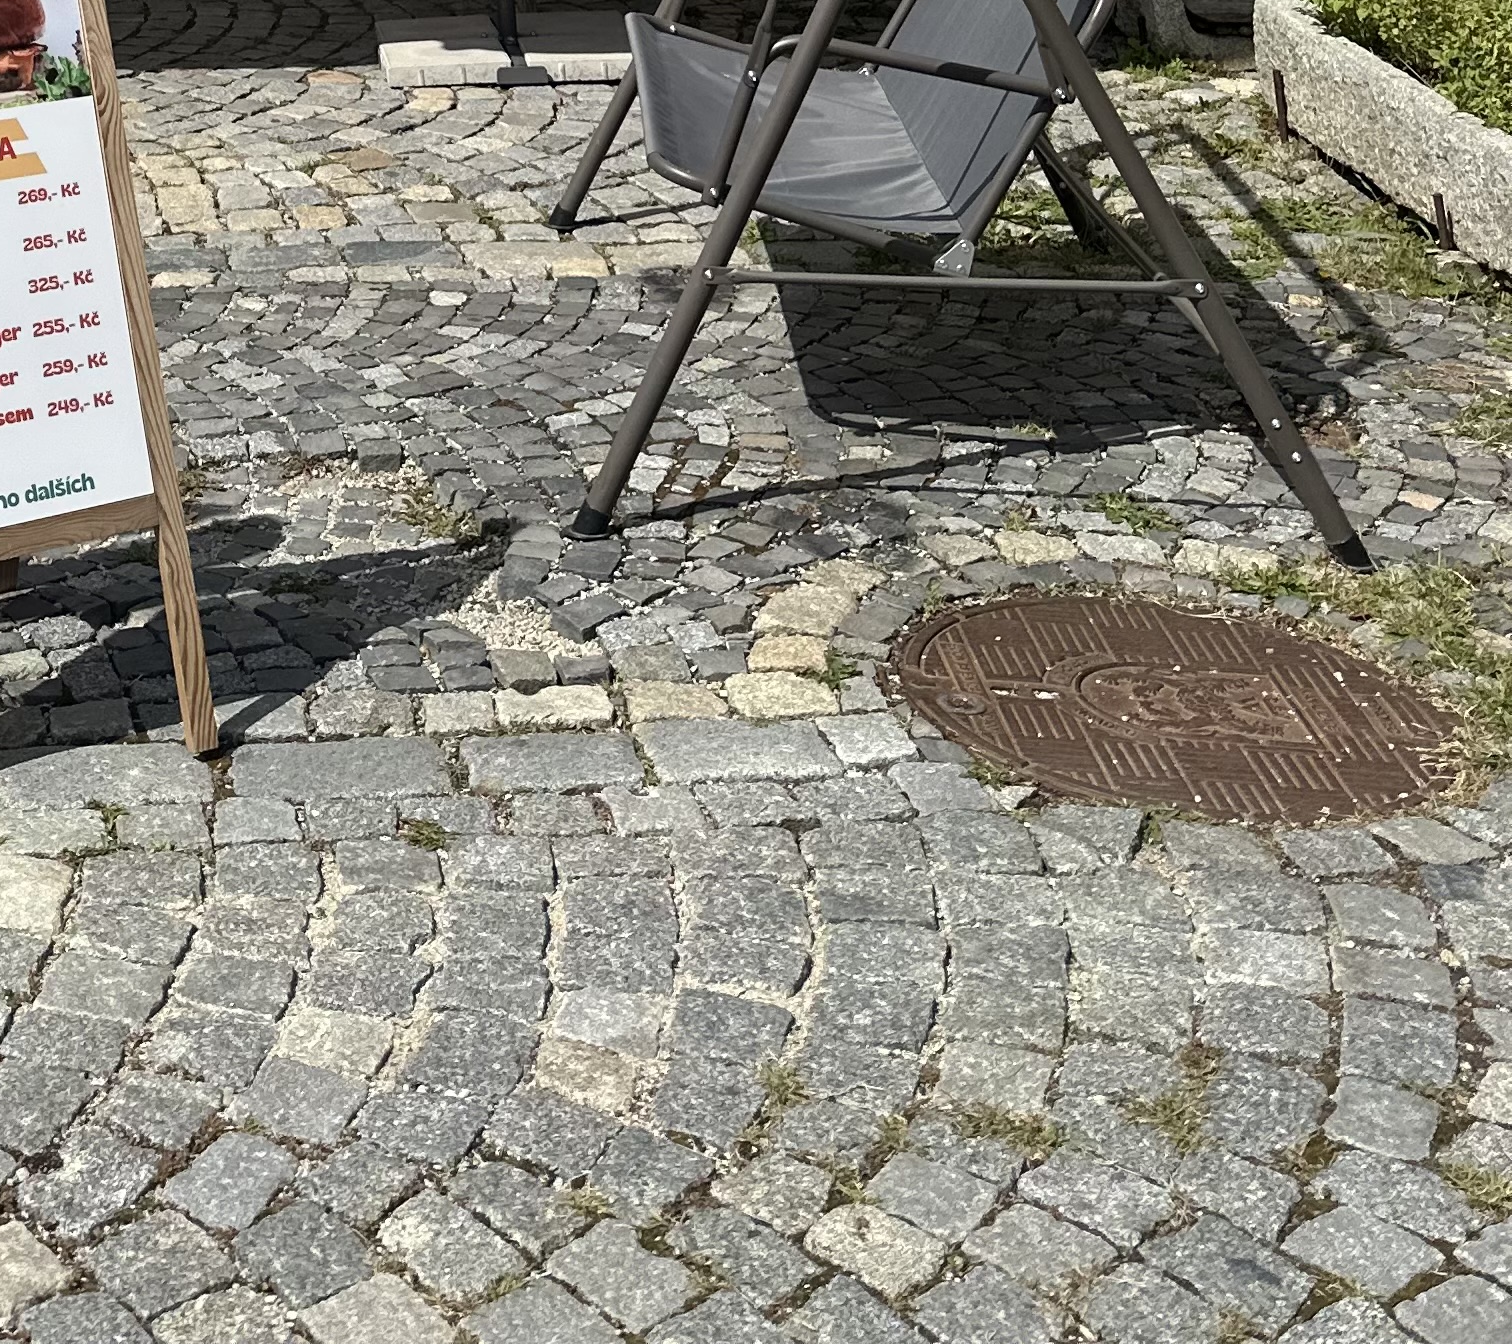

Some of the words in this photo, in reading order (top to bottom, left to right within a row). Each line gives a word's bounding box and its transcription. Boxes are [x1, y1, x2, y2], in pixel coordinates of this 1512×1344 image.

[18, 188, 57, 204] 269,-
[61, 182, 80, 197] Kč
[23, 234, 62, 251] 265,-
[67, 229, 87, 244] Kč
[28, 276, 69, 293] 325,-
[73, 269, 93, 285] Kč
[33, 319, 75, 337] 255,-
[80, 312, 100, 328] Kč
[43, 359, 84, 377] 259,-
[88, 352, 107, 368] Kč
[48, 398, 90, 416] 249,-
[94, 391, 113, 407] Kč
[25, 473, 95, 503] dalších
